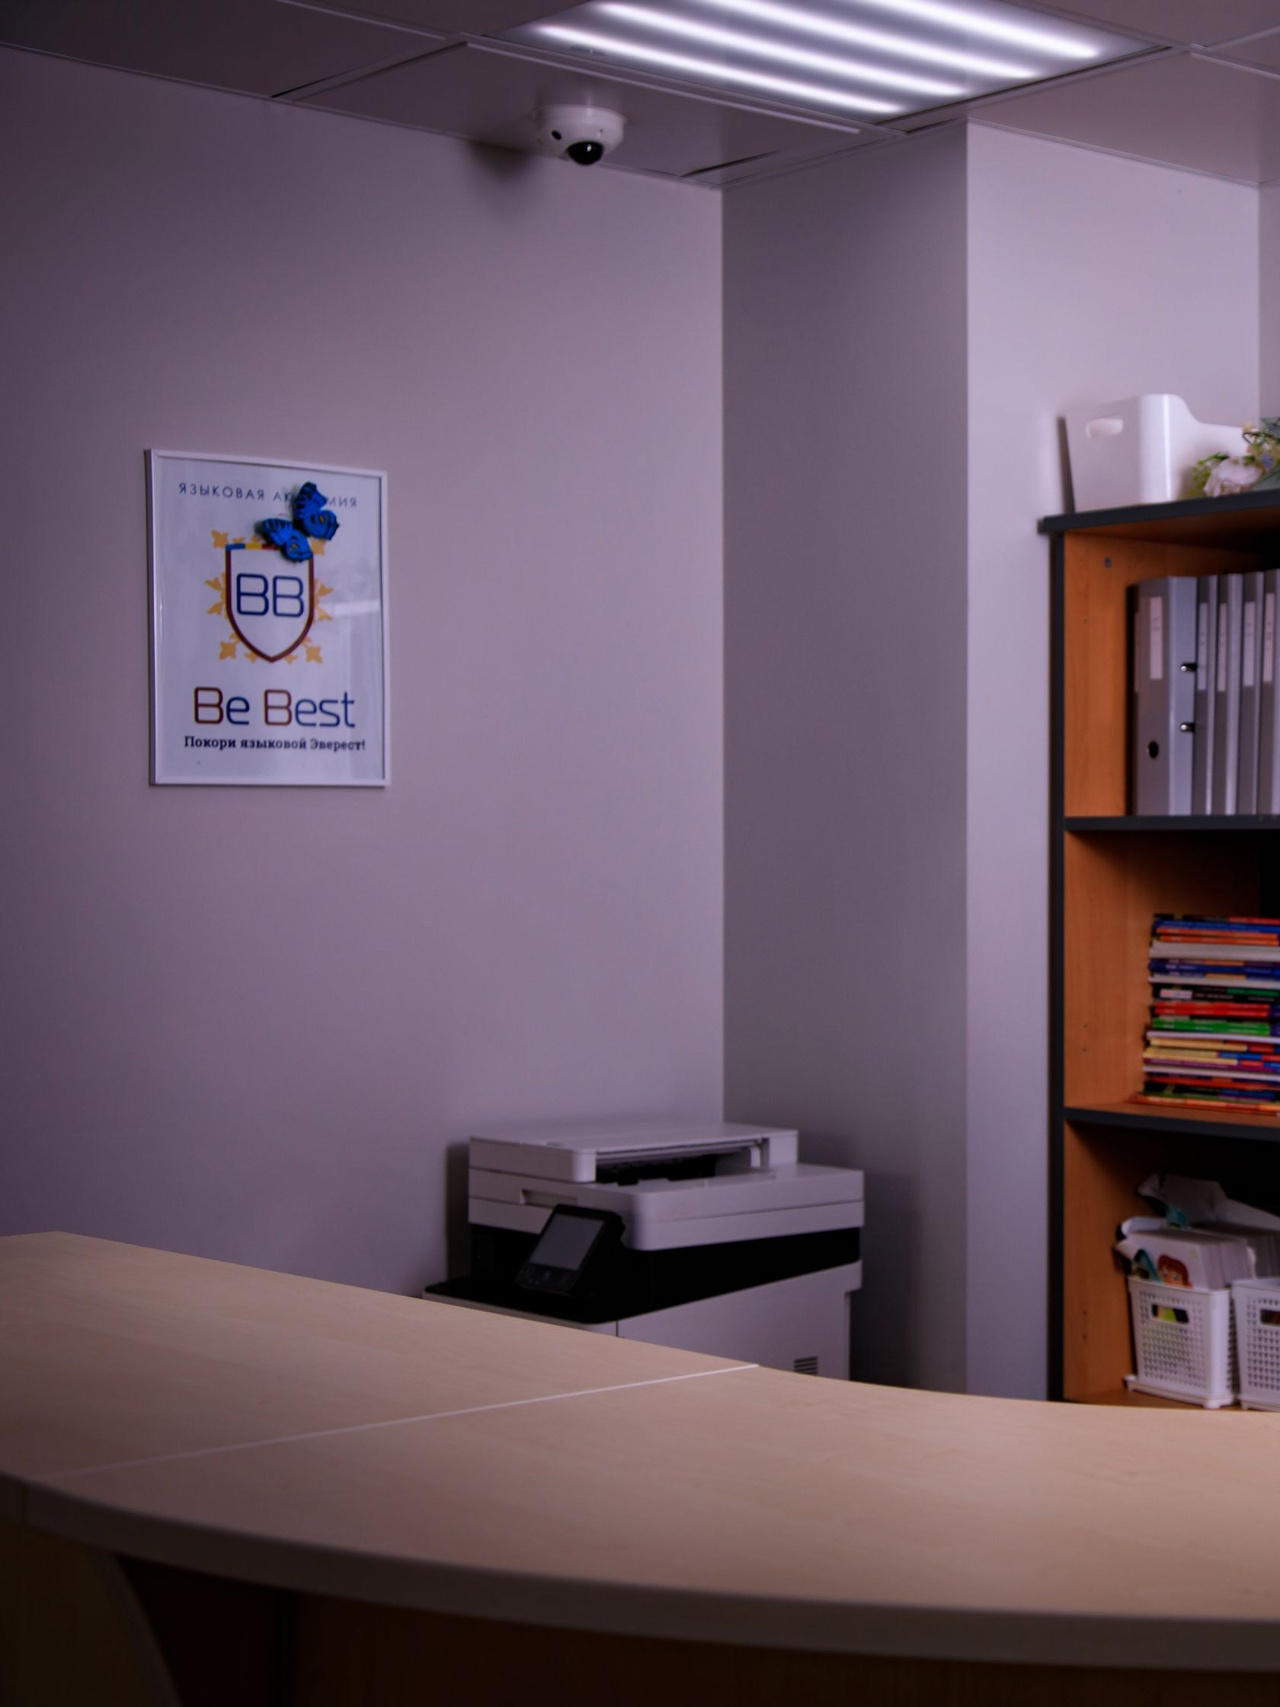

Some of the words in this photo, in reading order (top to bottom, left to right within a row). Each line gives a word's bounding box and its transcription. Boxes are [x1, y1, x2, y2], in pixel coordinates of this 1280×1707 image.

[178, 482, 265, 501] ЯЗЫКОВАЯ
[272, 490, 358, 508] АКМИЯ
[236, 572, 304, 618] BB
[193, 686, 250, 726] Be
[263, 688, 356, 728] Best
[184, 734, 237, 752] Покори
[239, 737, 307, 751] языковой
[309, 738, 366, 752] Эверест!
